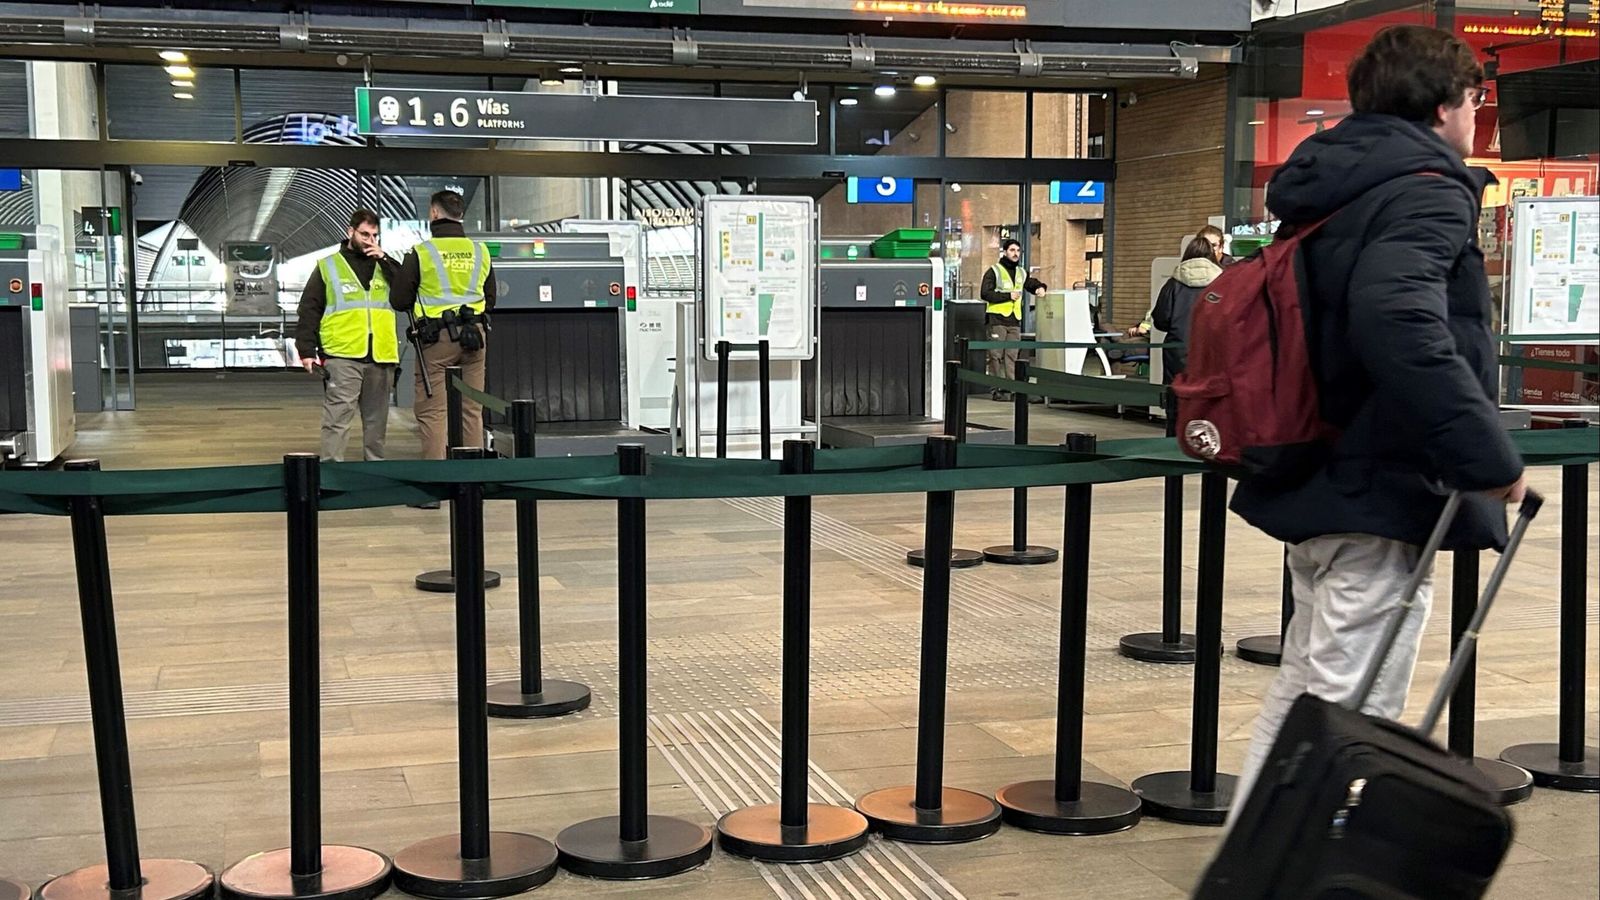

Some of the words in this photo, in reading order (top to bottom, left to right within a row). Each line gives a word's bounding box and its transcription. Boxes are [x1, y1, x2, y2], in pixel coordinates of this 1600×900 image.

[407, 97, 427, 126] 1
[433, 112, 444, 126] a
[450, 98, 469, 127] 6
[477, 98, 510, 115] Vías
[477, 119, 525, 129] PLATFORMS
[84, 220, 95, 235] 4
[1556, 349, 1570, 357] todo
